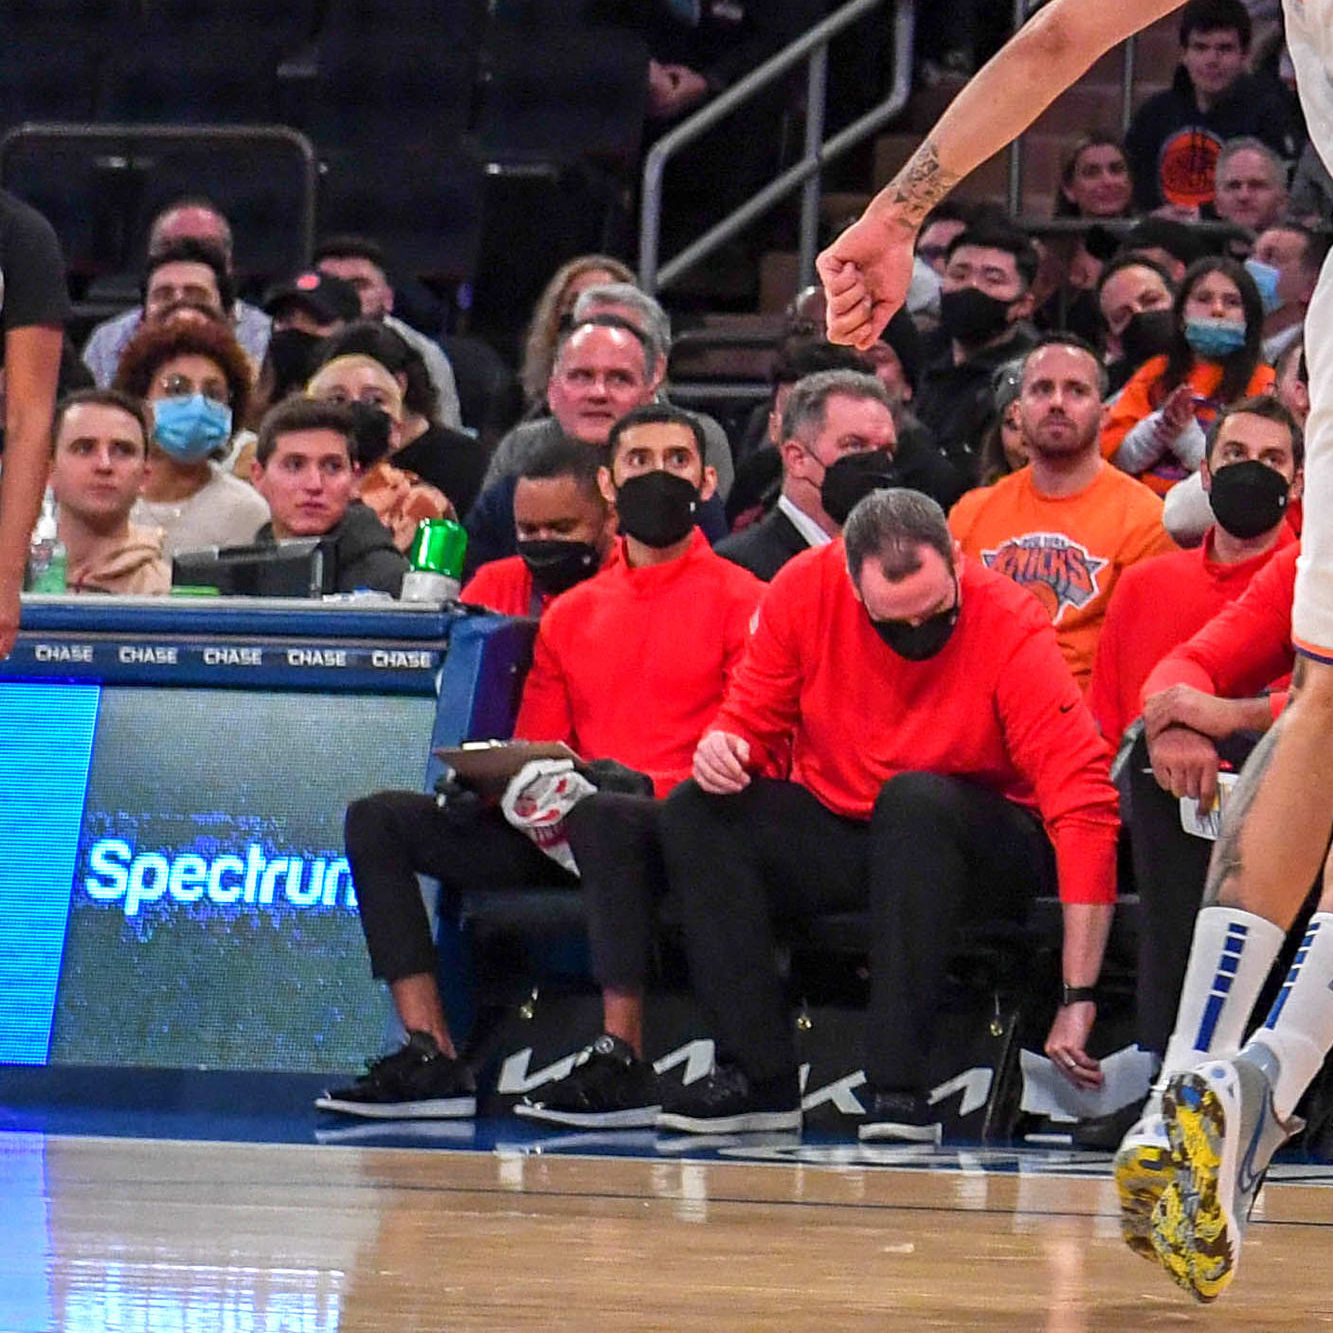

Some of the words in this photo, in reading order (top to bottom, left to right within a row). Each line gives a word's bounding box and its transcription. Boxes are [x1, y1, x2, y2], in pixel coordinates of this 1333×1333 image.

[34, 644, 94, 663] CHASE
[118, 646, 179, 665] CHASE
[203, 647, 263, 666] CHASE
[287, 649, 347, 667] CHASE
[371, 650, 432, 669] CHASE
